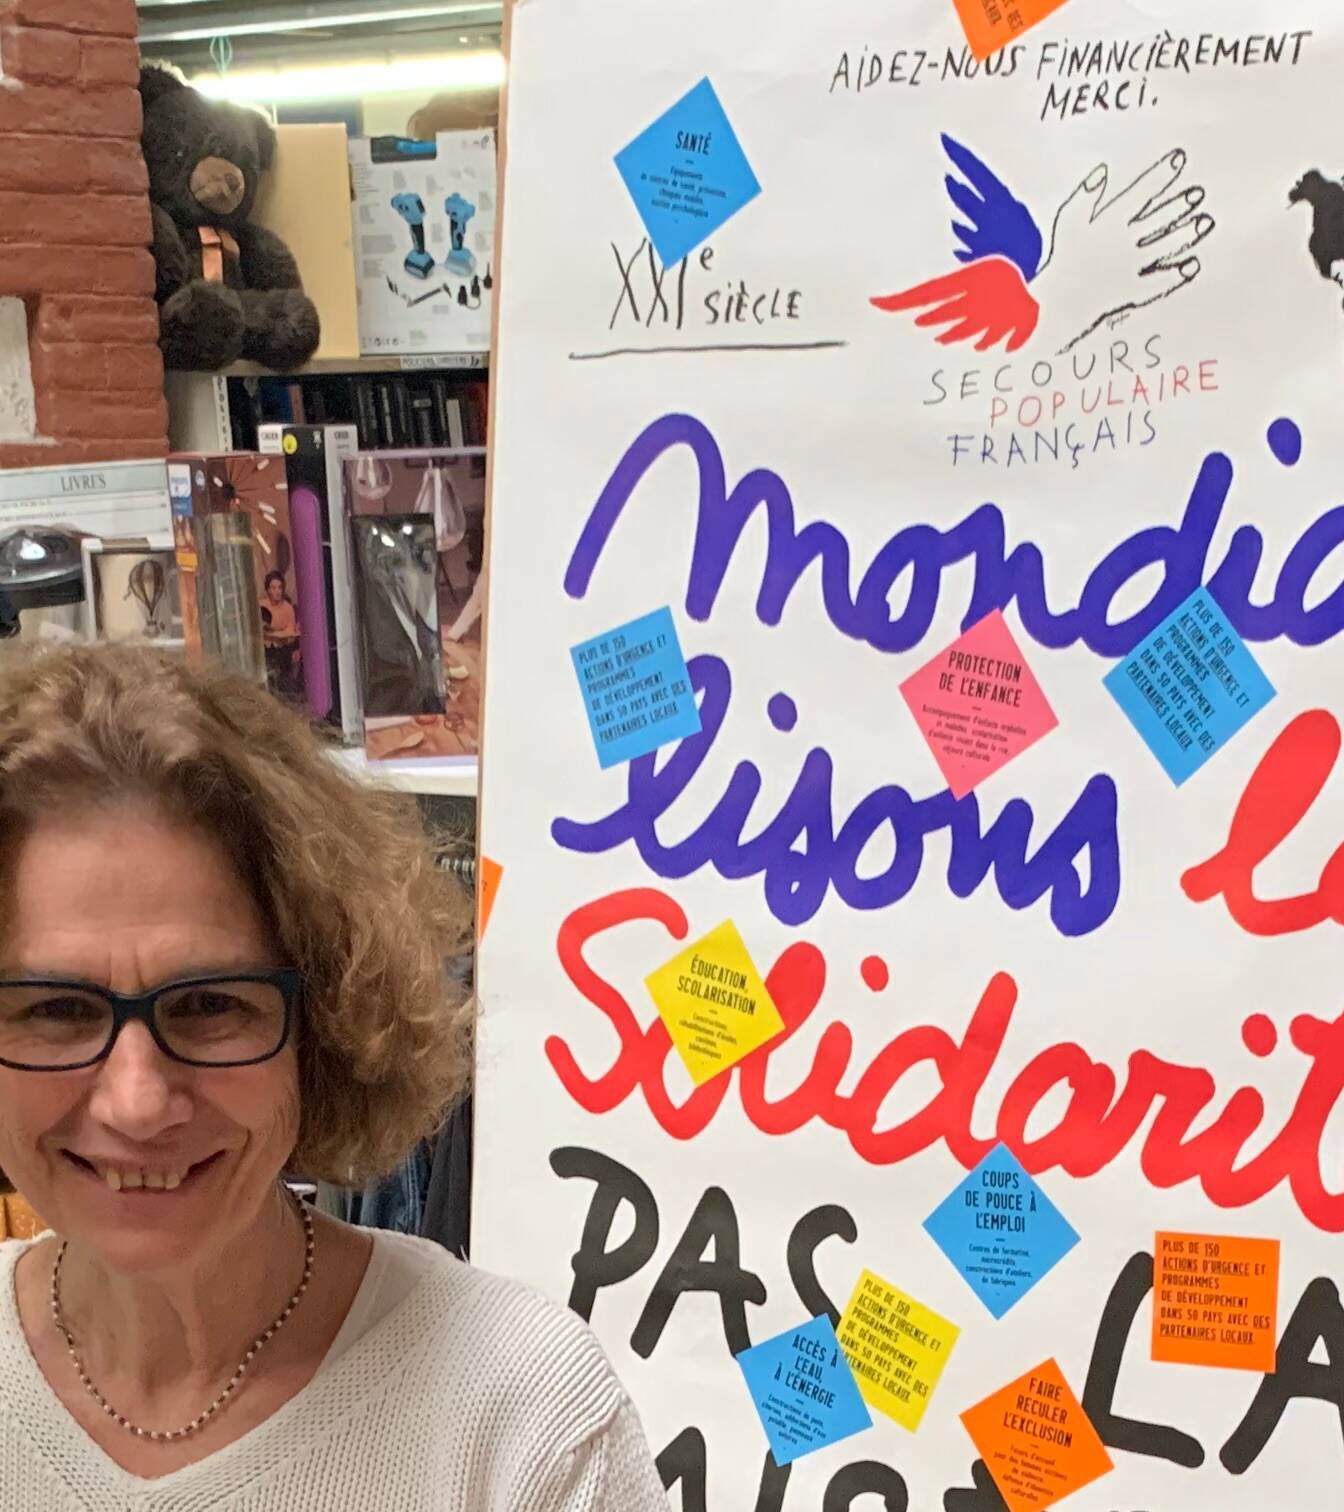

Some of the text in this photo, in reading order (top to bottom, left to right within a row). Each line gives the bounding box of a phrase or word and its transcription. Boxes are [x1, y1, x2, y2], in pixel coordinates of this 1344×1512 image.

[676, 130, 712, 155] SANTÉ
[924, 336, 1164, 406] SECOURS
[989, 360, 1221, 429] POPULAIRE
[947, 411, 1158, 468] FRANÇAIS
[60, 473, 106, 491] LIVRES
[1192, 598, 1236, 657] PLUS DE 150
[949, 650, 1022, 682] PROTECTION
[1167, 624, 1211, 681] PROGRAMMES
[1179, 612, 1251, 708] ACTIONS D'URGENCE ET
[939, 671, 1023, 707] DE L'ENFANCE
[1127, 661, 1171, 718] PARTENAIRES
[1153, 635, 1215, 718] DE DÉVELOPPEMENT
[1140, 648, 1216, 752] DANS 50 PAYS AVEC DES
[551, 653, 1122, 938] lisons
[678, 975, 757, 1015] SCOLARISATION
[982, 1169, 1020, 1189] COUPS
[965, 1189, 1037, 1212] DE POUCE À
[976, 1212, 1026, 1232] L'EMPLOI
[1163, 1239, 1221, 1257] PLUS DE 150
[1163, 1256, 1267, 1276] ACTIONS D'URGENCE ET
[864, 1278, 911, 1316] PLUS DE 150
[1161, 1289, 1249, 1308] DE DÉVELOPPEMENT
[1162, 1272, 1220, 1289] PROGRAMMES
[852, 1306, 900, 1342] PROGRAMMES
[858, 1293, 942, 1352] ACTIONS D'URGENCE ET
[1160, 1323, 1217, 1340] PARTENAIRES
[1161, 1306, 1271, 1330] DANS 50 PAYS AVEC DES
[792, 1333, 839, 1368] ACCÈS À
[846, 1319, 918, 1370] DE DÉVELOPPEMENT
[795, 1355, 824, 1383] L'EAU,
[841, 1333, 929, 1397] DANS 50 PAYS AVEC DES
[774, 1361, 836, 1408] À L'ÉNERGIE
[1029, 1376, 1063, 1402] FAIRE
[1016, 1394, 1068, 1424] RECULER
[1003, 1411, 1073, 1447] L'EXCLUSION
